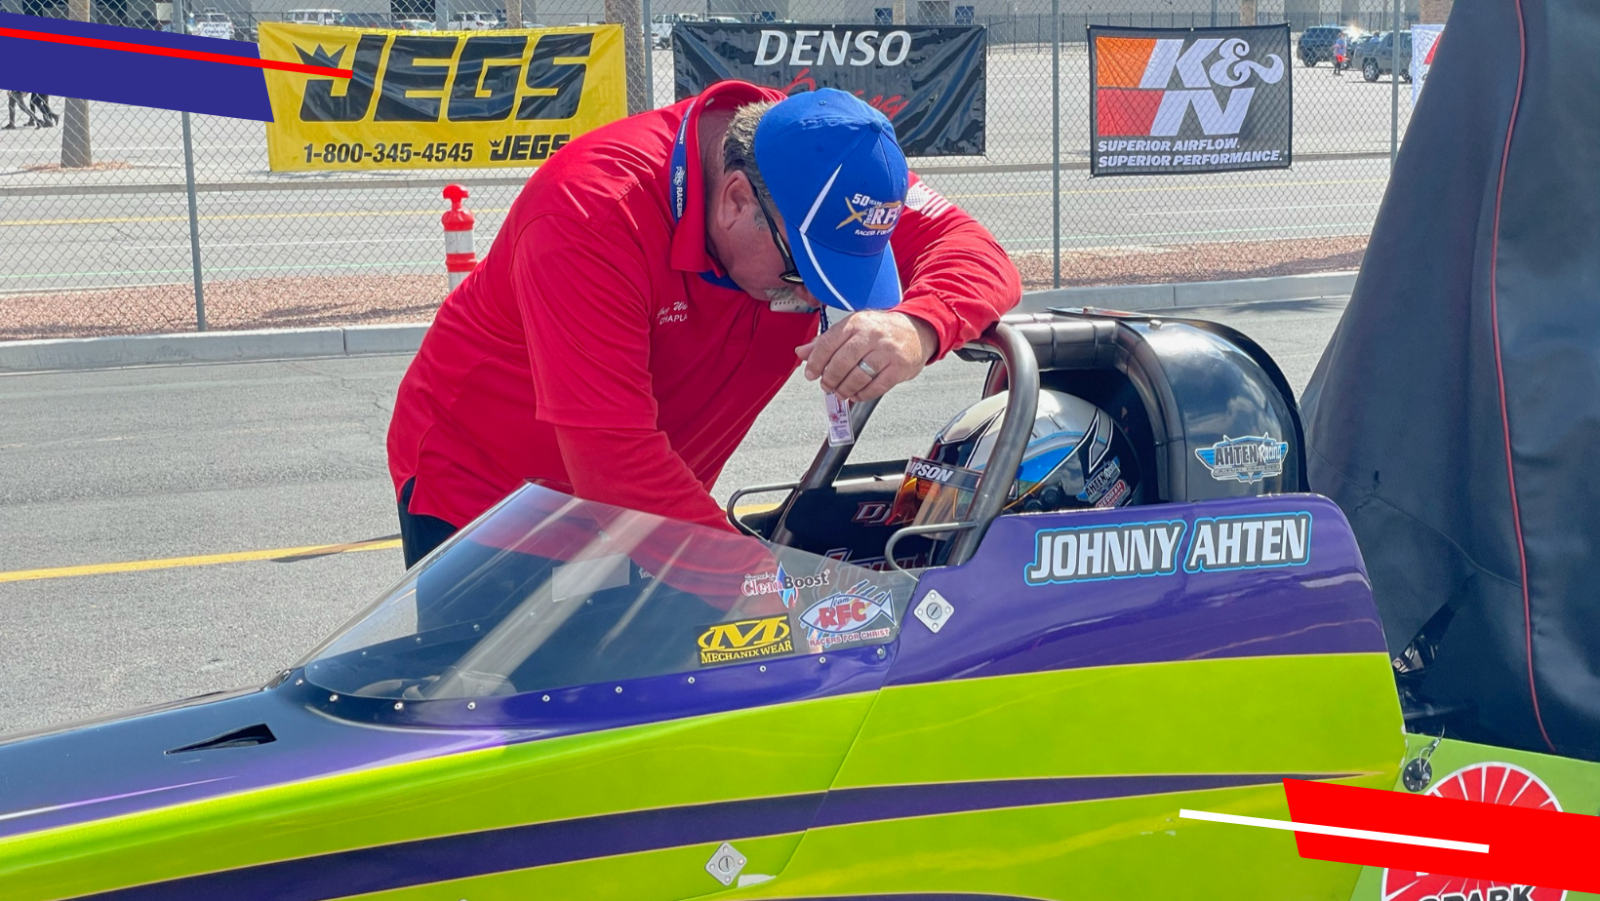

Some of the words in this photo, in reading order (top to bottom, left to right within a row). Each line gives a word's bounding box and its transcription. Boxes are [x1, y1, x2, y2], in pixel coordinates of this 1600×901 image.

[754, 29, 912, 66] DENSO
[299, 33, 595, 123] JEGS
[303, 142, 473, 164] 1-800-345-4545
[489, 134, 570, 161] JEGS
[1098, 140, 1171, 152] SUPERIOR
[1173, 137, 1240, 151] AIRFLOW.
[1098, 154, 1171, 167] SUPERIOR
[1172, 150, 1283, 166] PERFORMANCE.
[676, 186, 684, 218] RACERS
[852, 193, 870, 207] 50
[1215, 444, 1258, 466] AHTEN
[1258, 442, 1282, 463] Racing
[1030, 526, 1181, 580] JOHNNY
[1190, 518, 1307, 567] AHTEN
[829, 595, 850, 609] Team
[818, 601, 867, 629] RFC
[809, 636, 842, 647] RACERS
[843, 632, 861, 643] FOR
[861, 628, 890, 639] CHRIST
[700, 649, 760, 664] MECHANIX
[760, 640, 793, 655] WEAR
